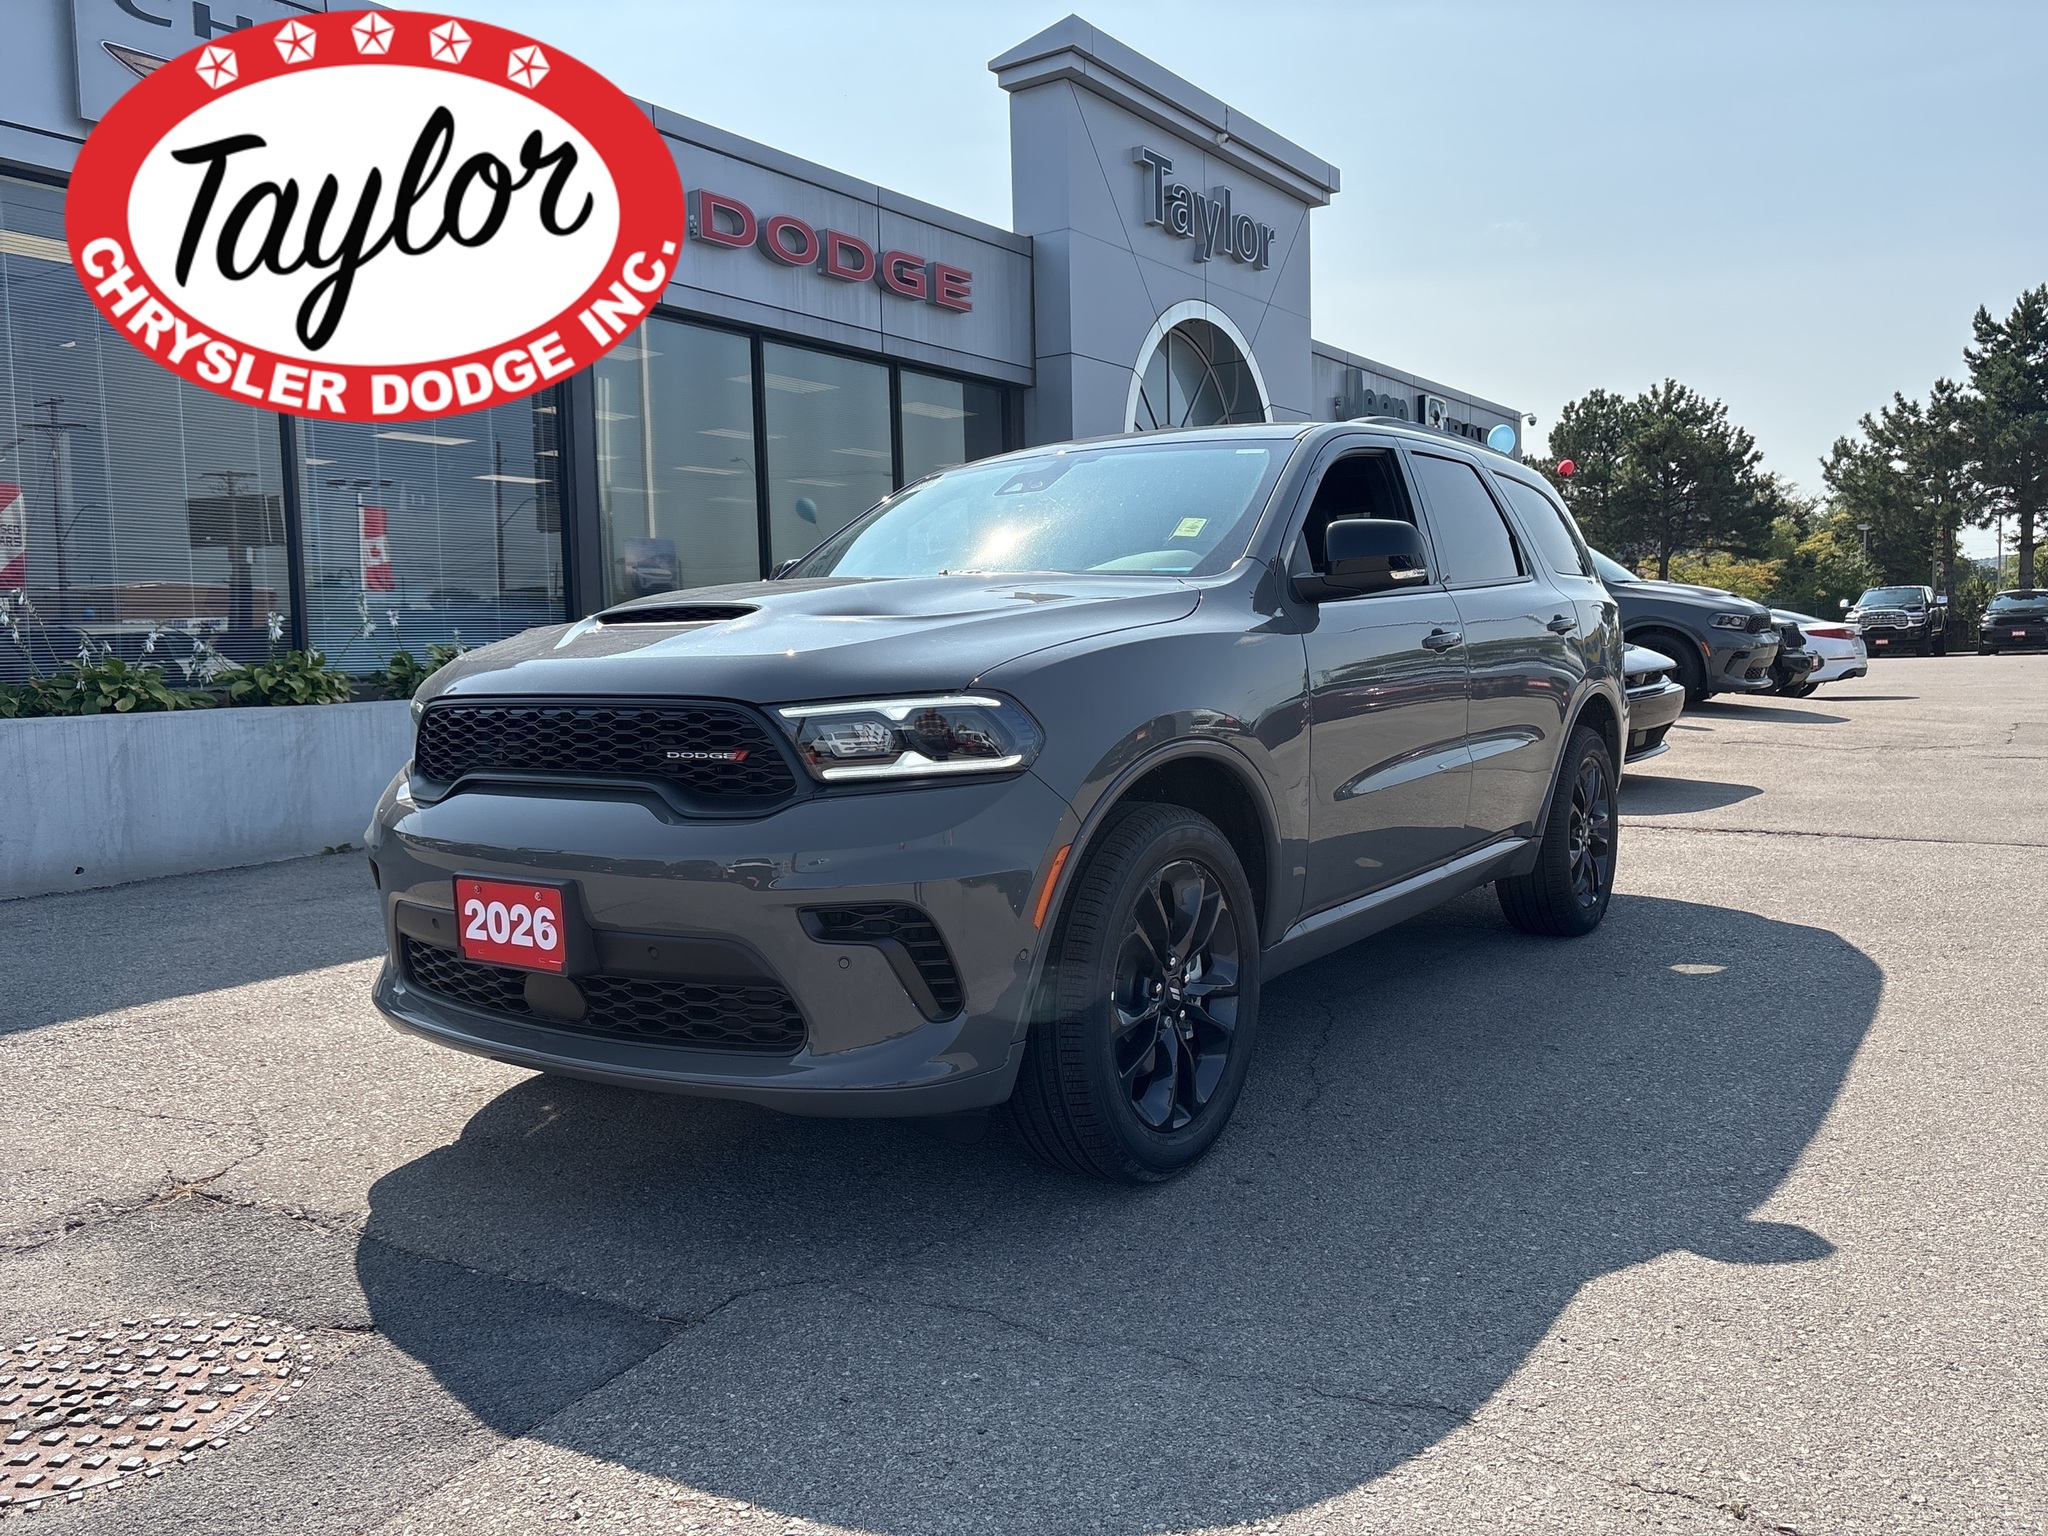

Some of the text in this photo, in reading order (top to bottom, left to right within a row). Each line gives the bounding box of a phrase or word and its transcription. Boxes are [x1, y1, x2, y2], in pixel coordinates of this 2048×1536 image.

[1141, 145, 1276, 270] Taylor
[698, 188, 973, 313] DODGE
[0, 524, 21, 535] SED
[666, 751, 737, 759] DODGE
[464, 898, 558, 951] 2026
